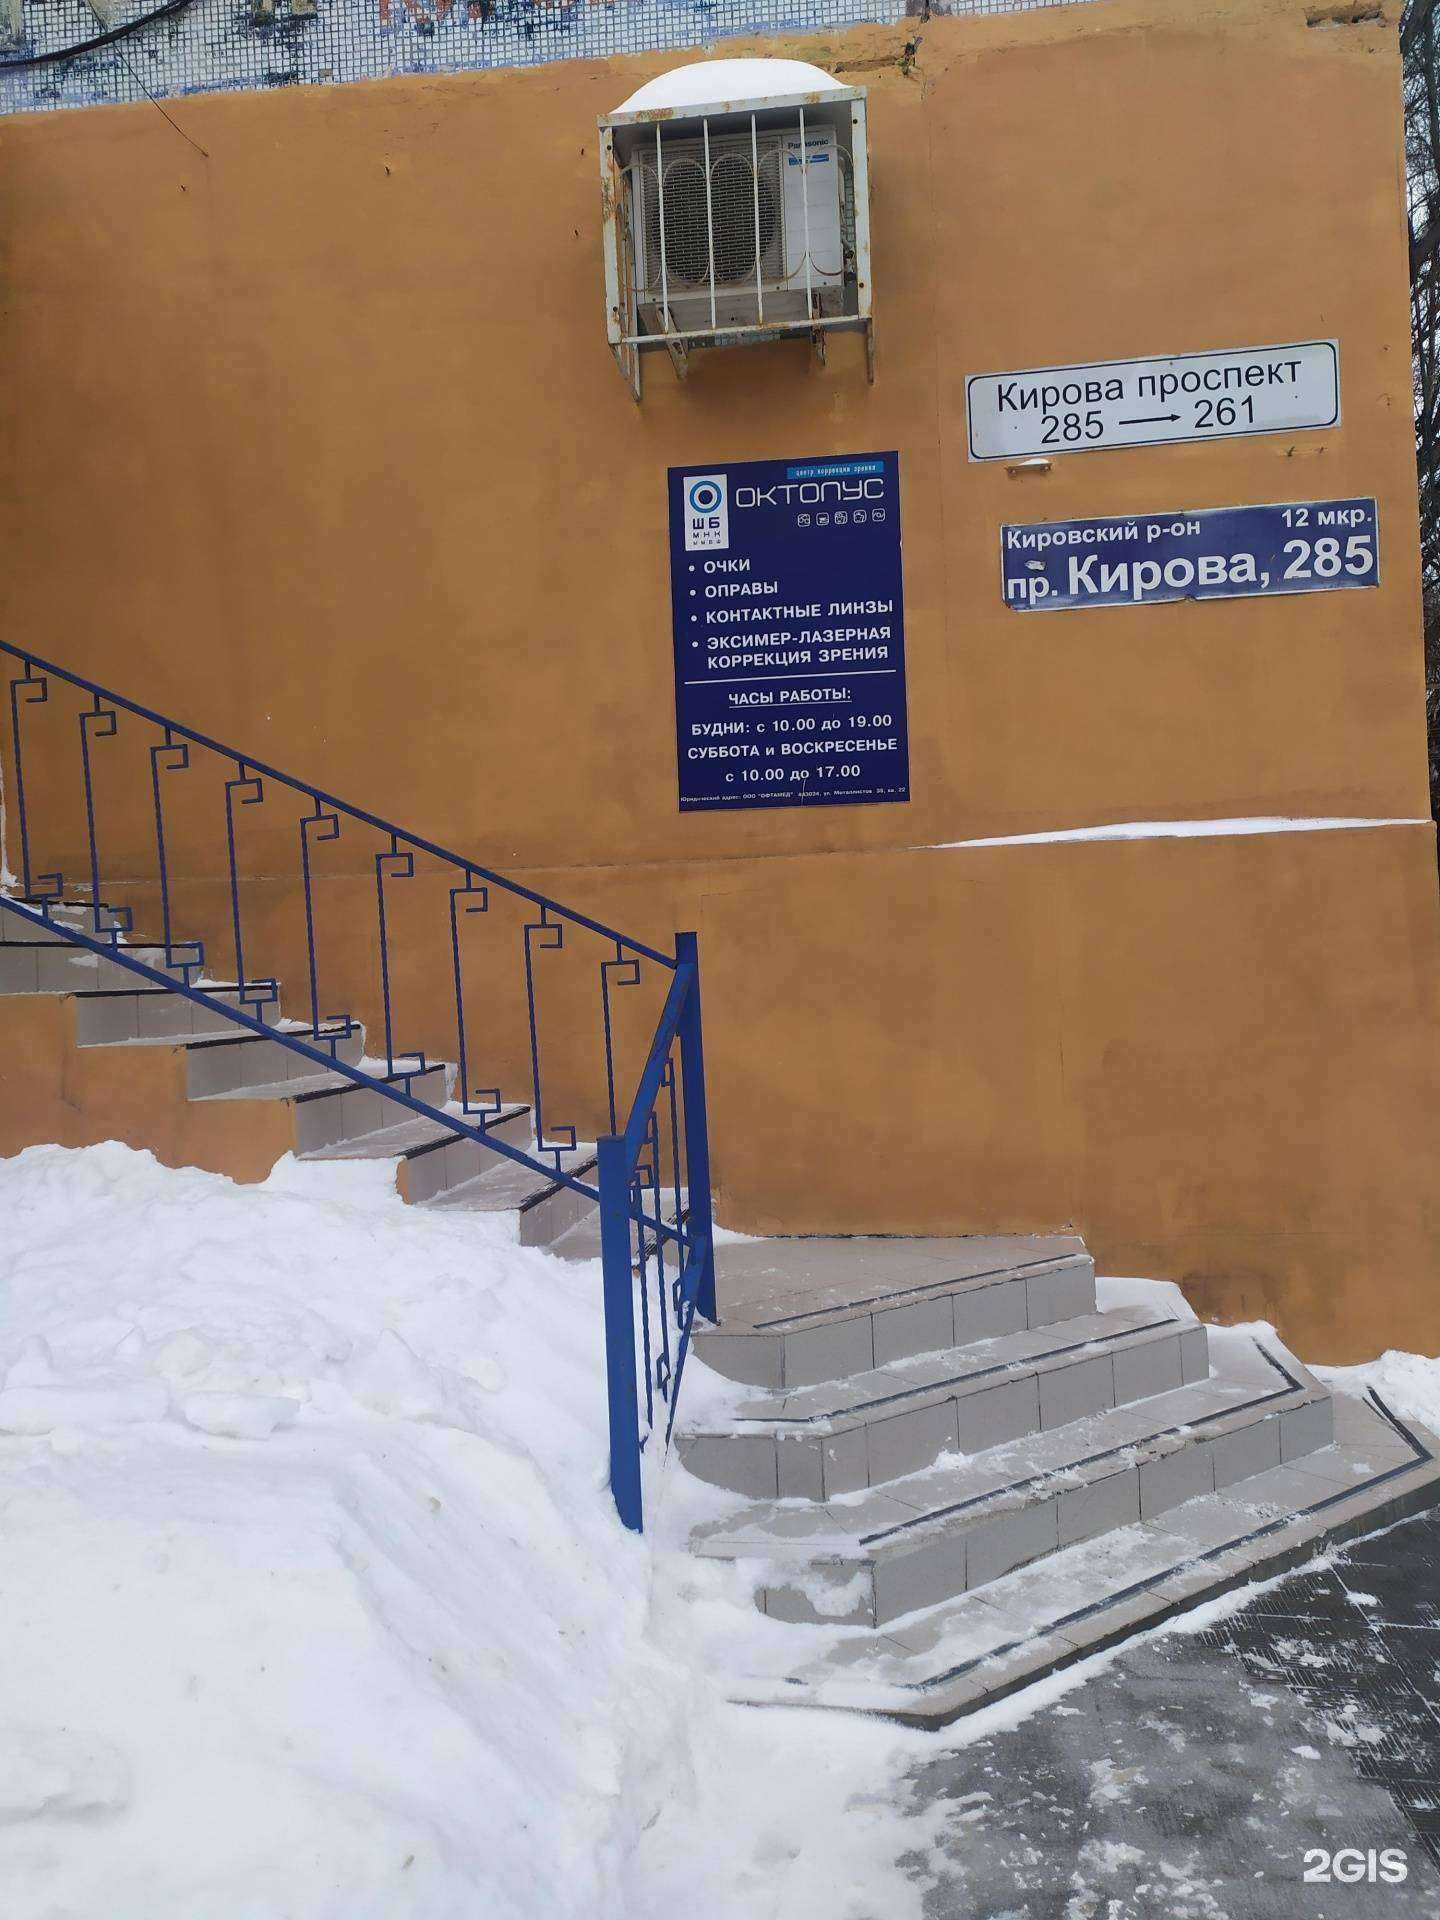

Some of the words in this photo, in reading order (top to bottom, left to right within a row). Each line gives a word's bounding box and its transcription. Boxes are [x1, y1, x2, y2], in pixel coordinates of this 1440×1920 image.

[997, 376, 1124, 412] Кирова
[1138, 360, 1302, 402] проспект
[1040, 410, 1104, 444] 285
[1194, 396, 1255, 429] 261
[735, 478, 885, 508] ОКТОПУС
[1282, 508, 1310, 528] 12
[1317, 506, 1373, 529] мкр.
[1007, 520, 1139, 551] Кировский
[1147, 519, 1201, 544] р-он
[703, 558, 751, 574] ОЧКИ
[1007, 575, 1059, 605] пр.
[1069, 550, 1270, 600] Кирова,
[1283, 534, 1374, 580] 285
[704, 581, 778, 598] ОПРАВЫ
[706, 603, 822, 624] КОНТАКТНЫЕ
[828, 599, 893, 616] ЛИНЗЫ
[707, 626, 892, 649] ЭКСИМЕР-ЛАЗЕРНАЯ
[708, 650, 812, 669] КОРРЕКЦИЯ
[818, 646, 889, 662] ЗРЕНИЯ
[728, 692, 774, 705] ЧАСЫ
[780, 687, 852, 703] РАБОТЫ:
[691, 722, 750, 737] БУДНИ:
[756, 722, 766, 733] с
[772, 718, 816, 732] 10.00
[821, 719, 841, 731] до
[848, 714, 892, 728] 19.00
[687, 744, 760, 760] СУББОТА
[765, 746, 775, 756] и
[781, 738, 898, 755] ВОСКРЕСЕНЬЕ
[725, 772, 734, 782] с
[741, 768, 784, 782] 10.00
[790, 769, 810, 781] до
[816, 764, 861, 778] 17.00
